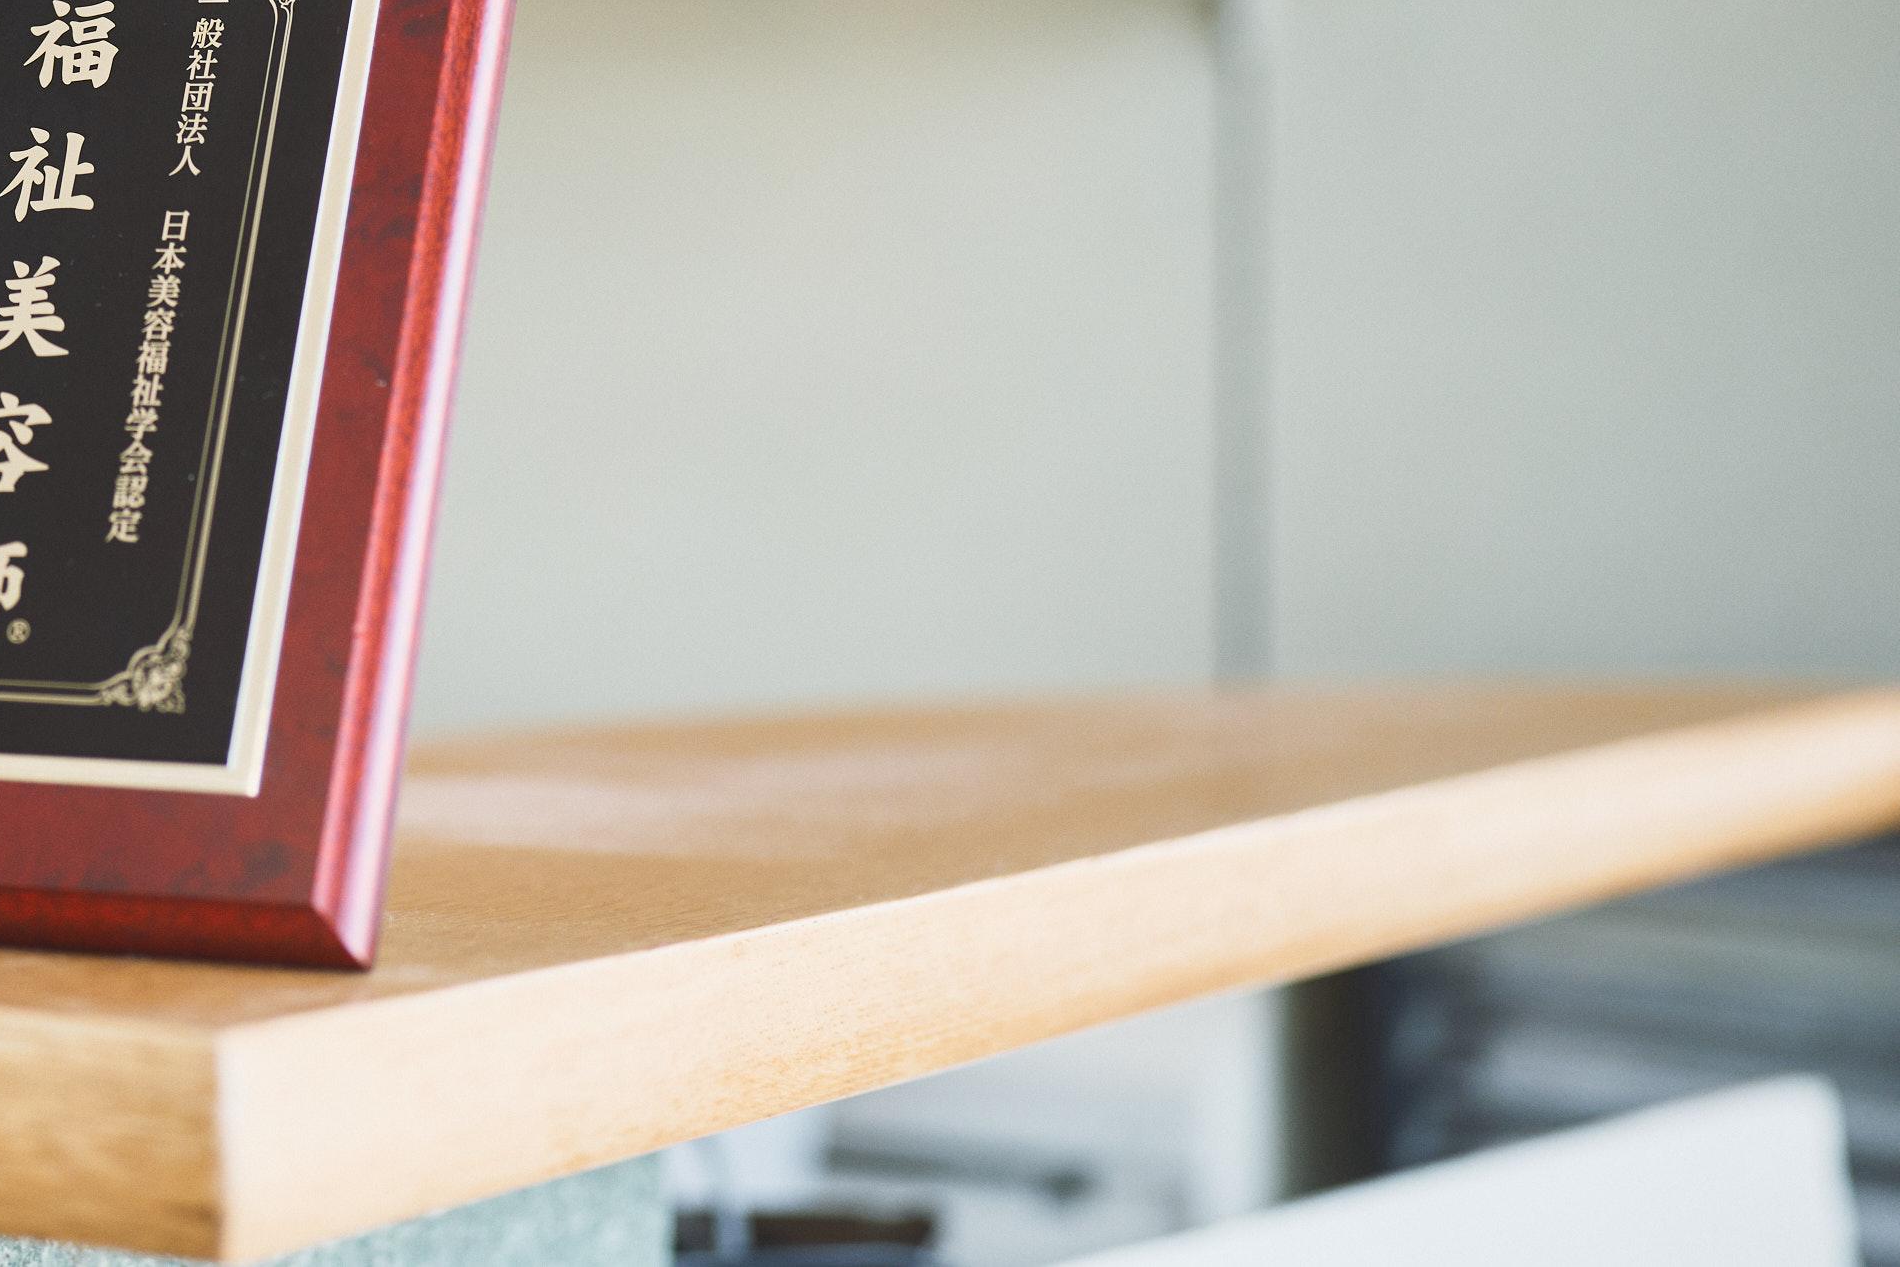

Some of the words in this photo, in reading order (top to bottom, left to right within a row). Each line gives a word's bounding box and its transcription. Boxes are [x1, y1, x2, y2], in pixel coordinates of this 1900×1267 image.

[104, 209, 191, 544] 日本美容福祉学会認定
